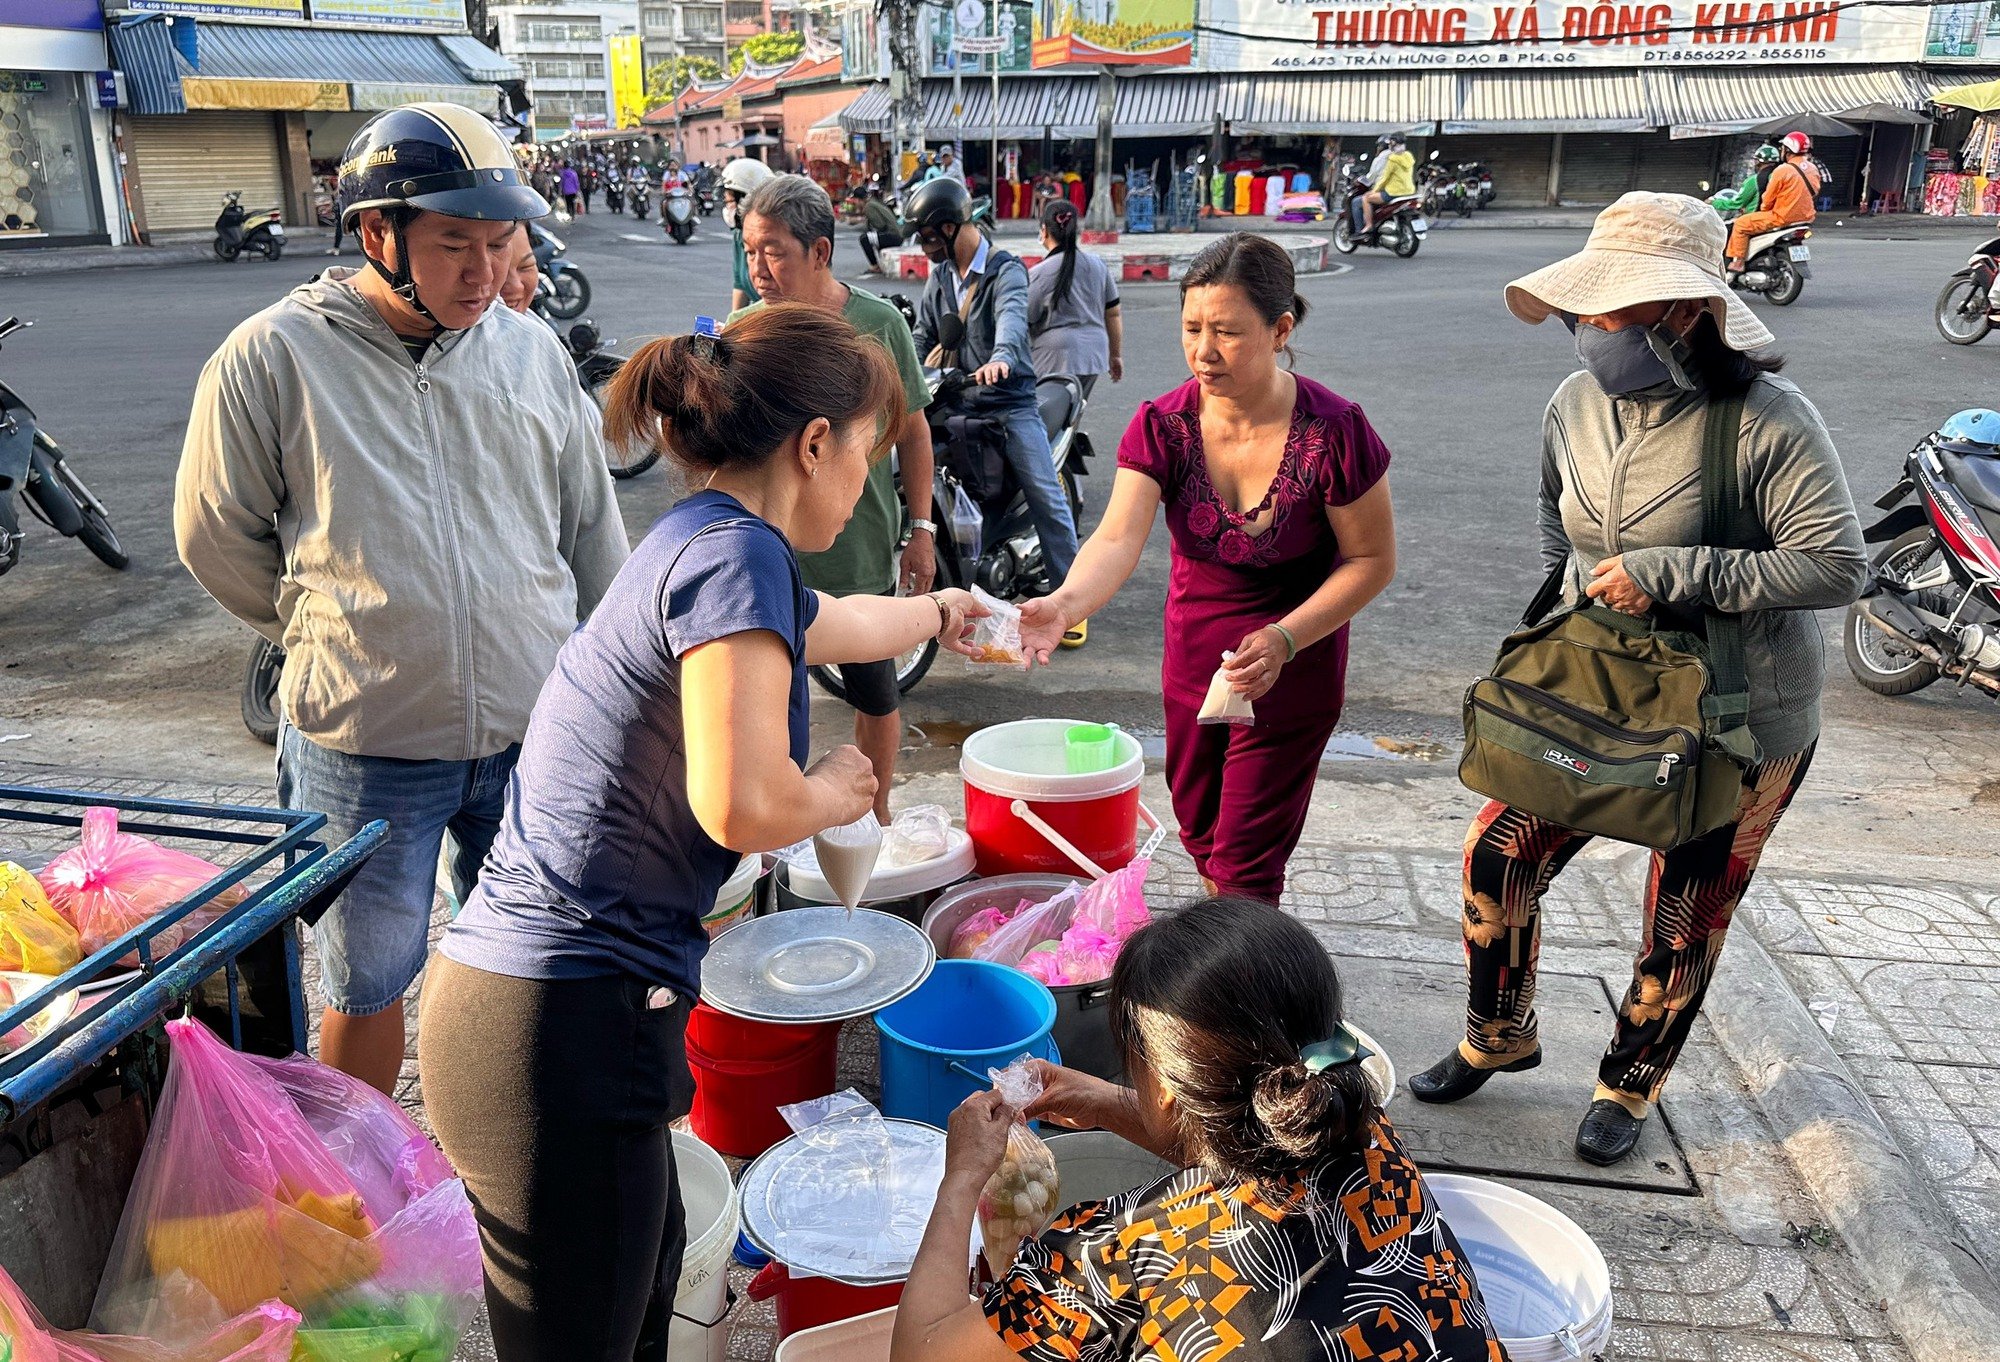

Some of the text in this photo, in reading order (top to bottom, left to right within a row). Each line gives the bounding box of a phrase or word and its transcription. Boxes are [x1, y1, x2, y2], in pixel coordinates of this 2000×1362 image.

[1491, 0, 1540, 46] XÁ
[1343, 51, 1391, 66] TRẦN
[1397, 53, 1447, 65] HƯNG
[1456, 53, 1490, 67] ĐẠO
[1498, 52, 1508, 62] B
[1518, 53, 1576, 63] P14.Q5
[1760, 48, 1826, 59] 8555115
[318, 83, 340, 95] 459
[1939, 489, 1985, 538] SIRIUS
